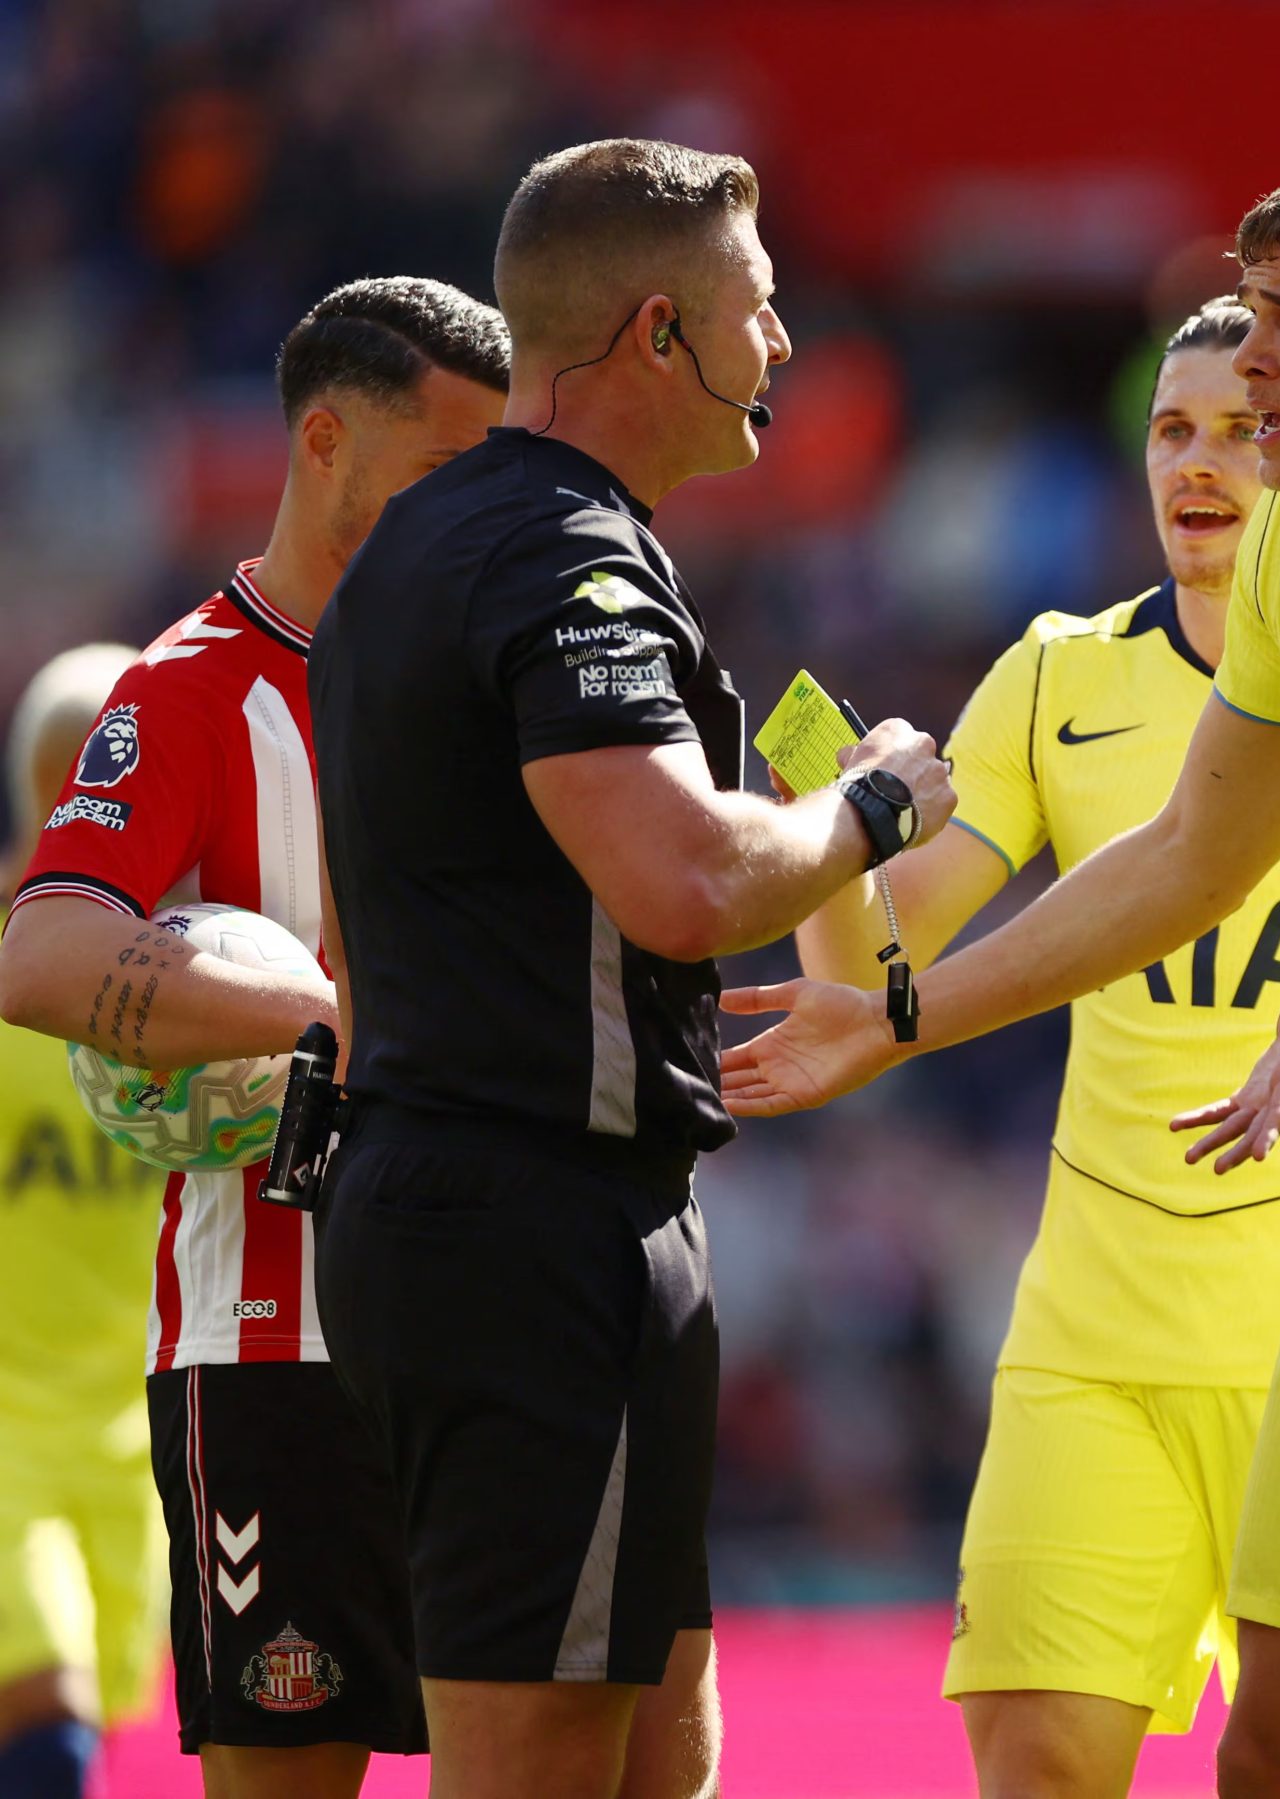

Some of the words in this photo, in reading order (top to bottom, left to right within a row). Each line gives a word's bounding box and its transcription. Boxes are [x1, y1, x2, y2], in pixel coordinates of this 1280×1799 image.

[555, 621, 662, 646] HuwsGr
[564, 645, 620, 667] Buildin
[579, 664, 608, 682] No
[611, 664, 657, 680] room
[72, 796, 121, 816] room
